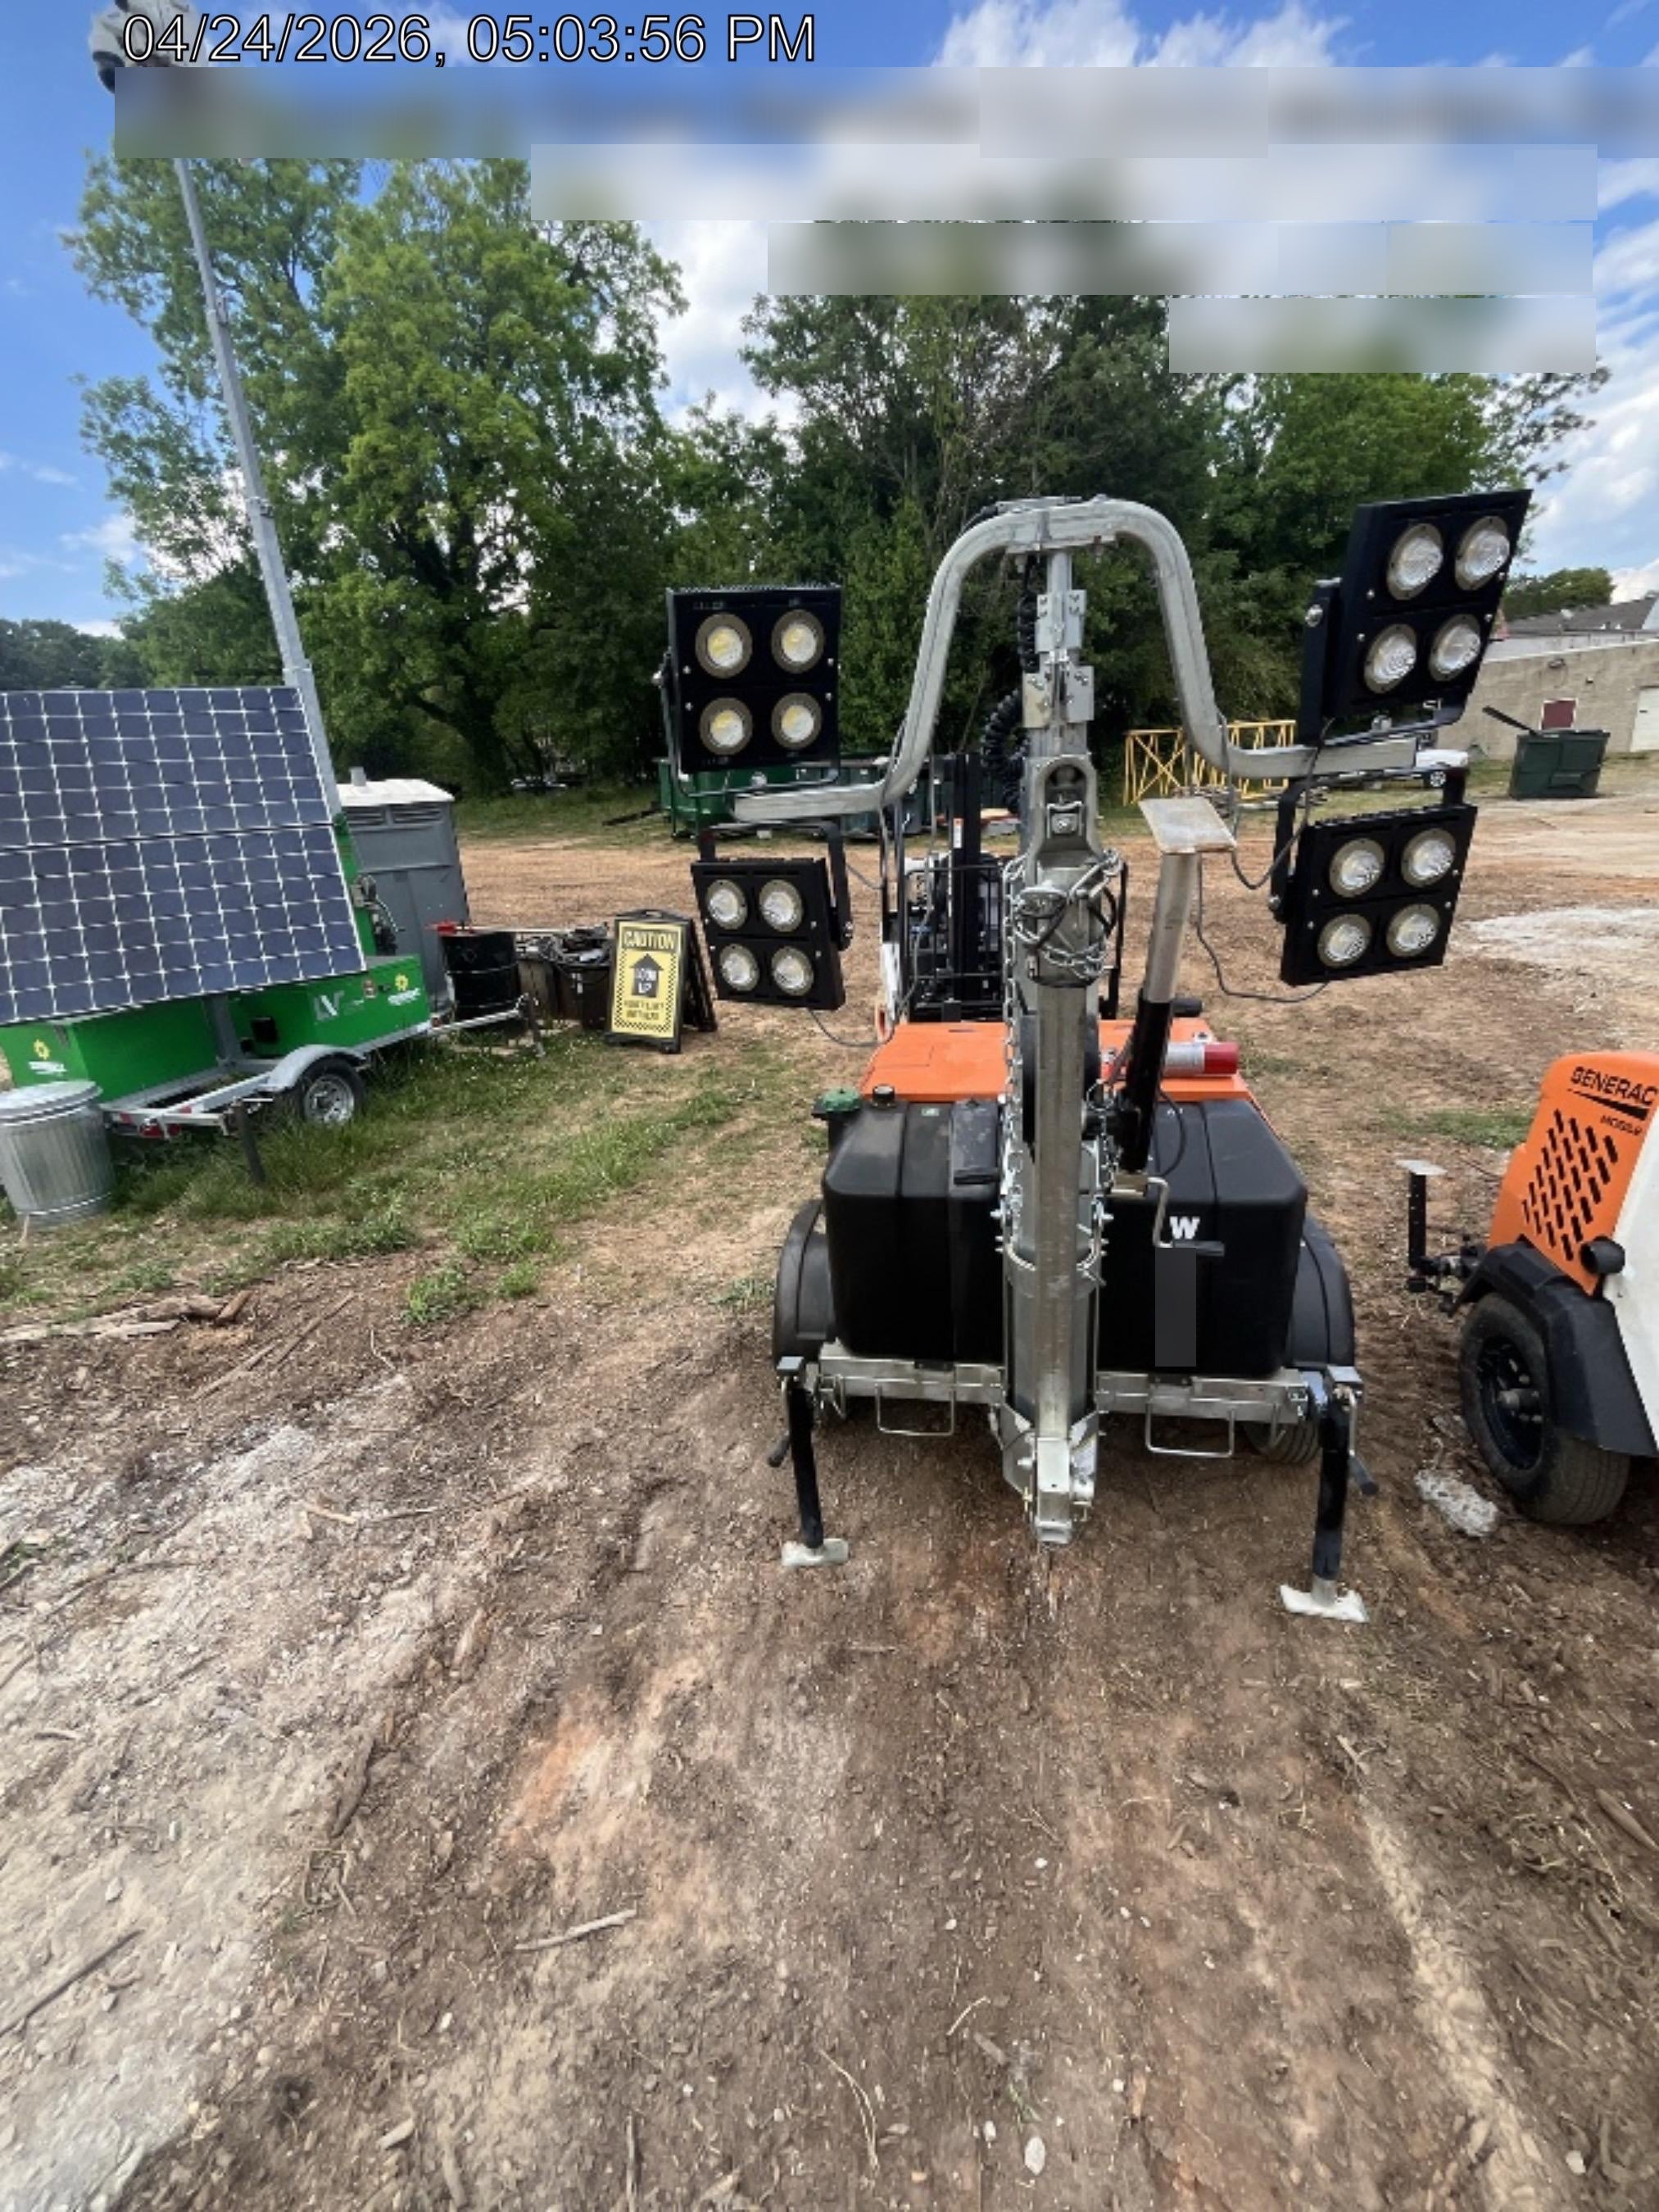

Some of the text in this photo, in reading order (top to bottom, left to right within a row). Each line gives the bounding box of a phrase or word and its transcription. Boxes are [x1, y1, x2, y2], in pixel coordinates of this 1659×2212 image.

[626, 930, 675, 950] CAUTION
[1571, 1066, 1658, 1105] GENERAC
[1170, 1216, 1200, 1240] W
